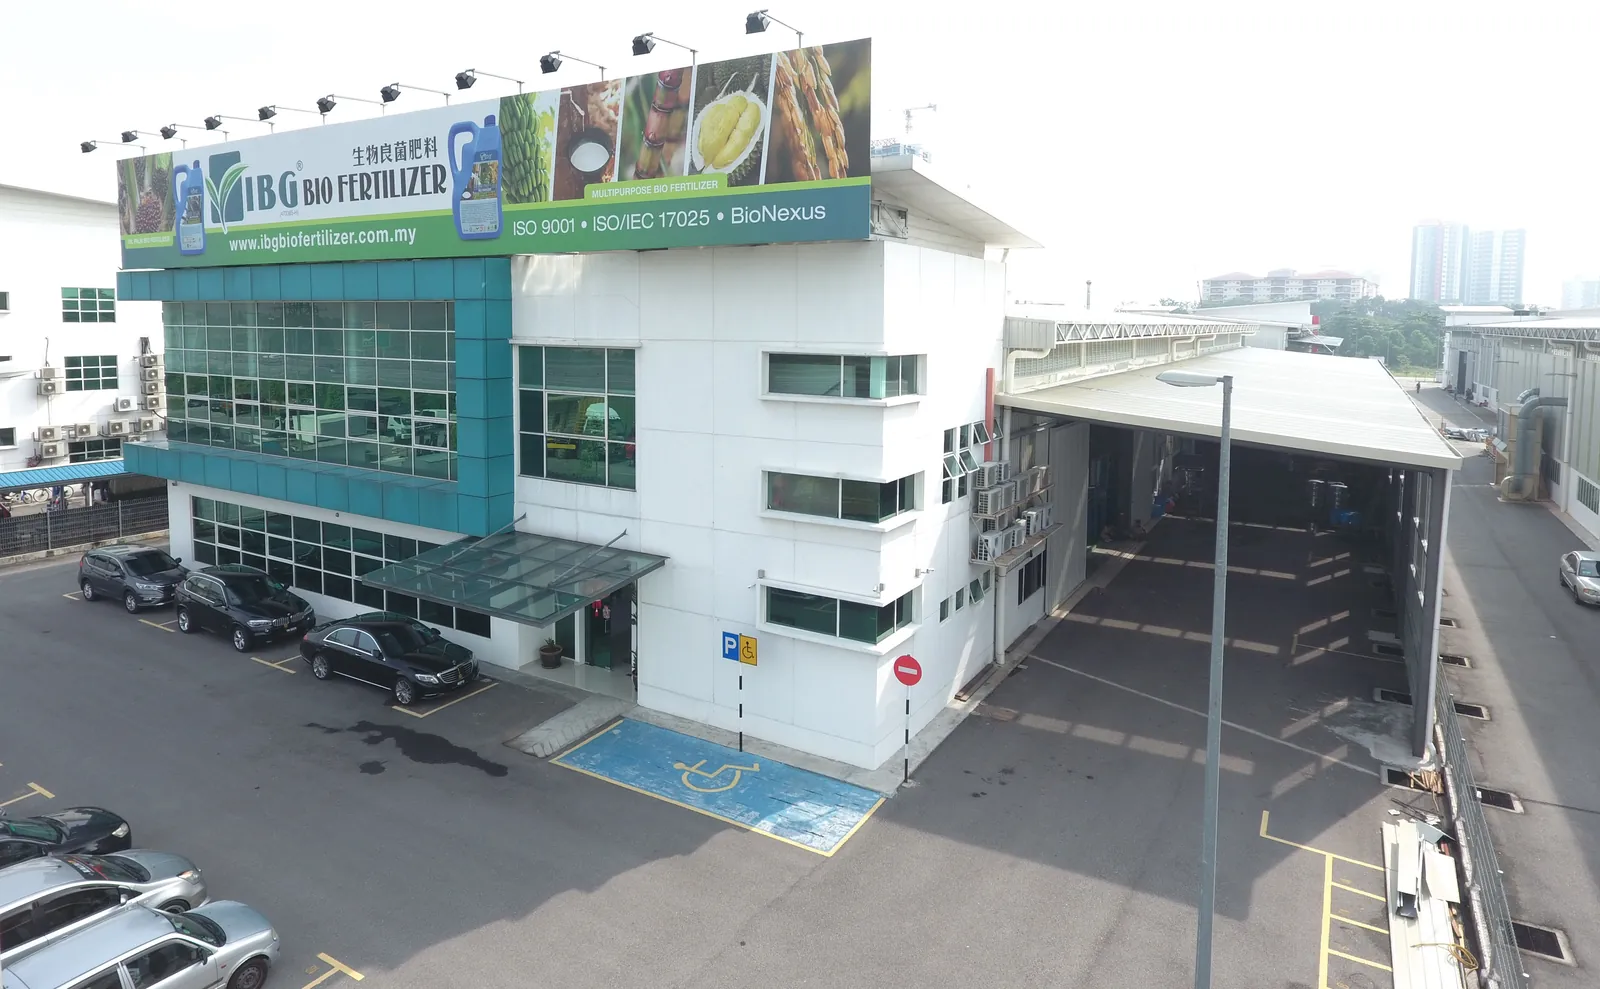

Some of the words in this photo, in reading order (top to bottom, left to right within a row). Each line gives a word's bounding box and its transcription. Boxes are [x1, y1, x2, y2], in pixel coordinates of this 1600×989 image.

[352, 136, 438, 167] 生物良菌肥料
[303, 176, 333, 206] BIO
[337, 164, 447, 203] FERTILIZER
[592, 185, 652, 199] MULTIPURPOSE
[653, 184, 669, 194] BIO
[670, 180, 718, 192] FERTILIZER
[513, 220, 537, 236] ISO
[541, 218, 575, 235] 9001
[593, 212, 654, 232] ISO/IEC
[659, 209, 710, 228] 17025
[731, 204, 826, 224] BioNexus
[229, 228, 417, 252] www.ibgbiofertilizer.com.my
[724, 636, 737, 655] P
